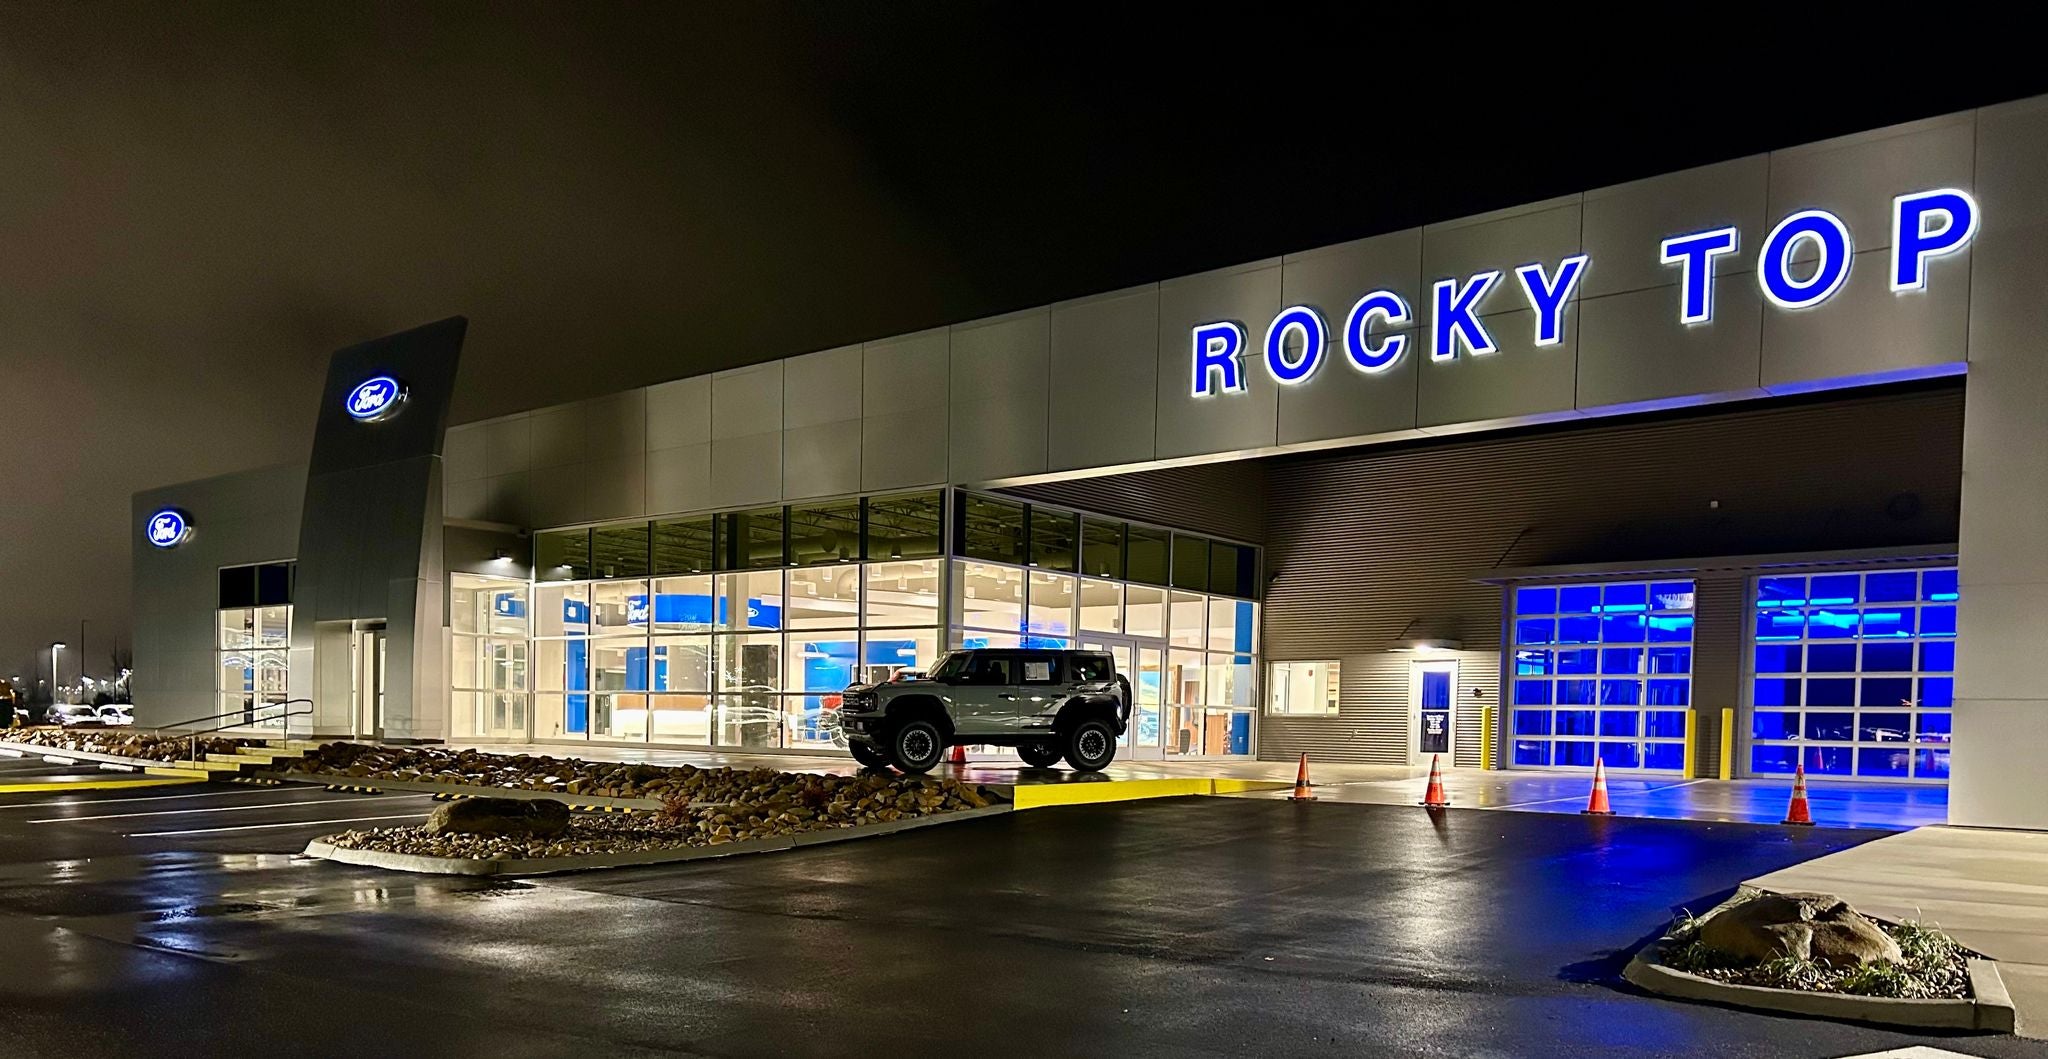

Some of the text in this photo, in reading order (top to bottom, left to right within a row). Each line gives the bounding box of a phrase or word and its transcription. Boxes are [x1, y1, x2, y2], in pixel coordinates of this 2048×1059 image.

[1191, 187, 1979, 398] ROCKY TOP
[354, 384, 387, 411] Ford
[153, 517, 176, 540] Ford
[628, 600, 649, 621] Ford
